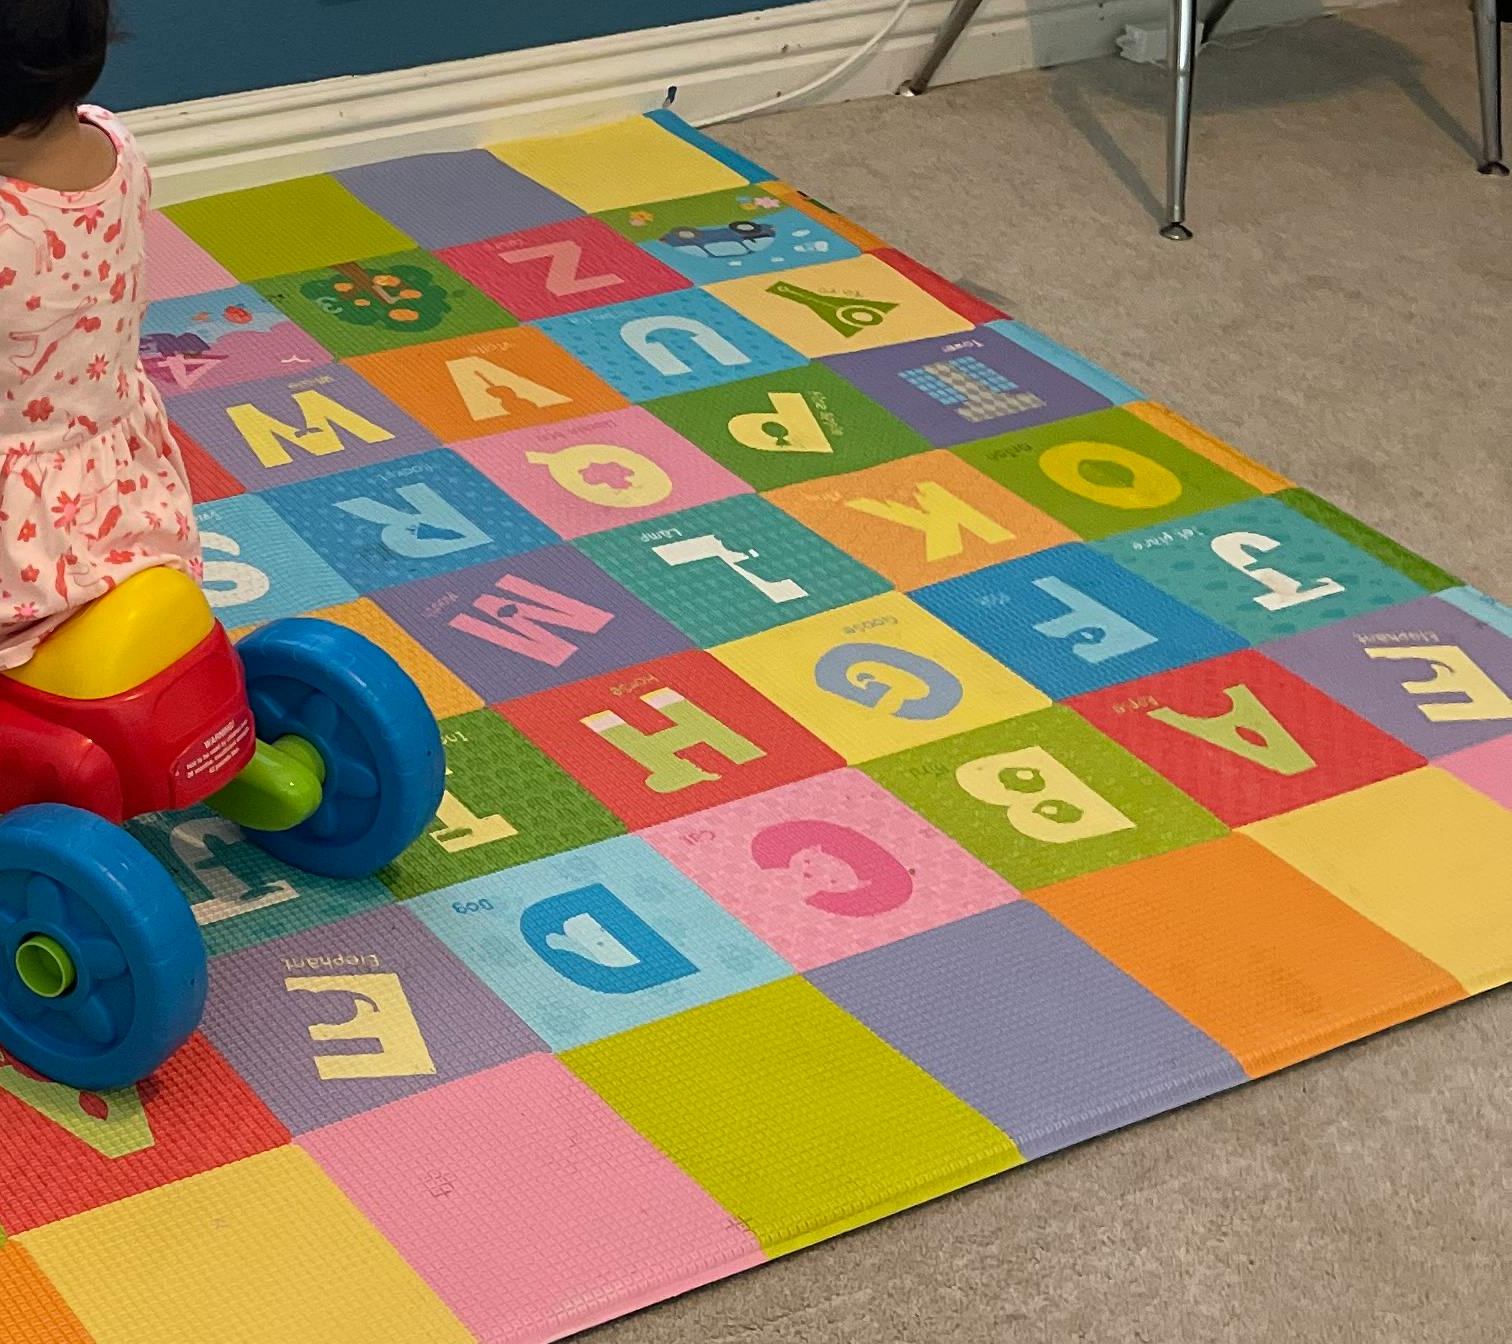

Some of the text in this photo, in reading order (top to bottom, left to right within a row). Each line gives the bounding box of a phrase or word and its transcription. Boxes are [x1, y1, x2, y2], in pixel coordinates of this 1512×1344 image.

[498, 241, 624, 297] Z
[765, 280, 899, 337] Y
[157, 353, 223, 390] 4
[621, 315, 751, 375] U
[445, 356, 573, 420] V
[728, 392, 835, 453] P
[897, 356, 1047, 423] T
[226, 389, 395, 467] W
[525, 444, 672, 508] Q
[1039, 441, 1183, 508] O
[332, 482, 493, 557] R
[640, 527, 683, 543] Lamp
[846, 481, 1016, 562] K
[652, 534, 808, 604] L
[1210, 531, 1345, 611] J
[449, 573, 614, 668] M
[842, 615, 899, 635] Goose
[1032, 576, 1158, 662] F
[814, 643, 964, 719] G
[1364, 645, 1512, 721] E
[580, 687, 767, 793] H
[1146, 684, 1317, 775] A
[955, 746, 1136, 842] B
[750, 819, 915, 917] C
[452, 897, 495, 914] Dog
[520, 883, 699, 994] D
[284, 953, 380, 971] Elephant
[284, 973, 436, 1079] E
